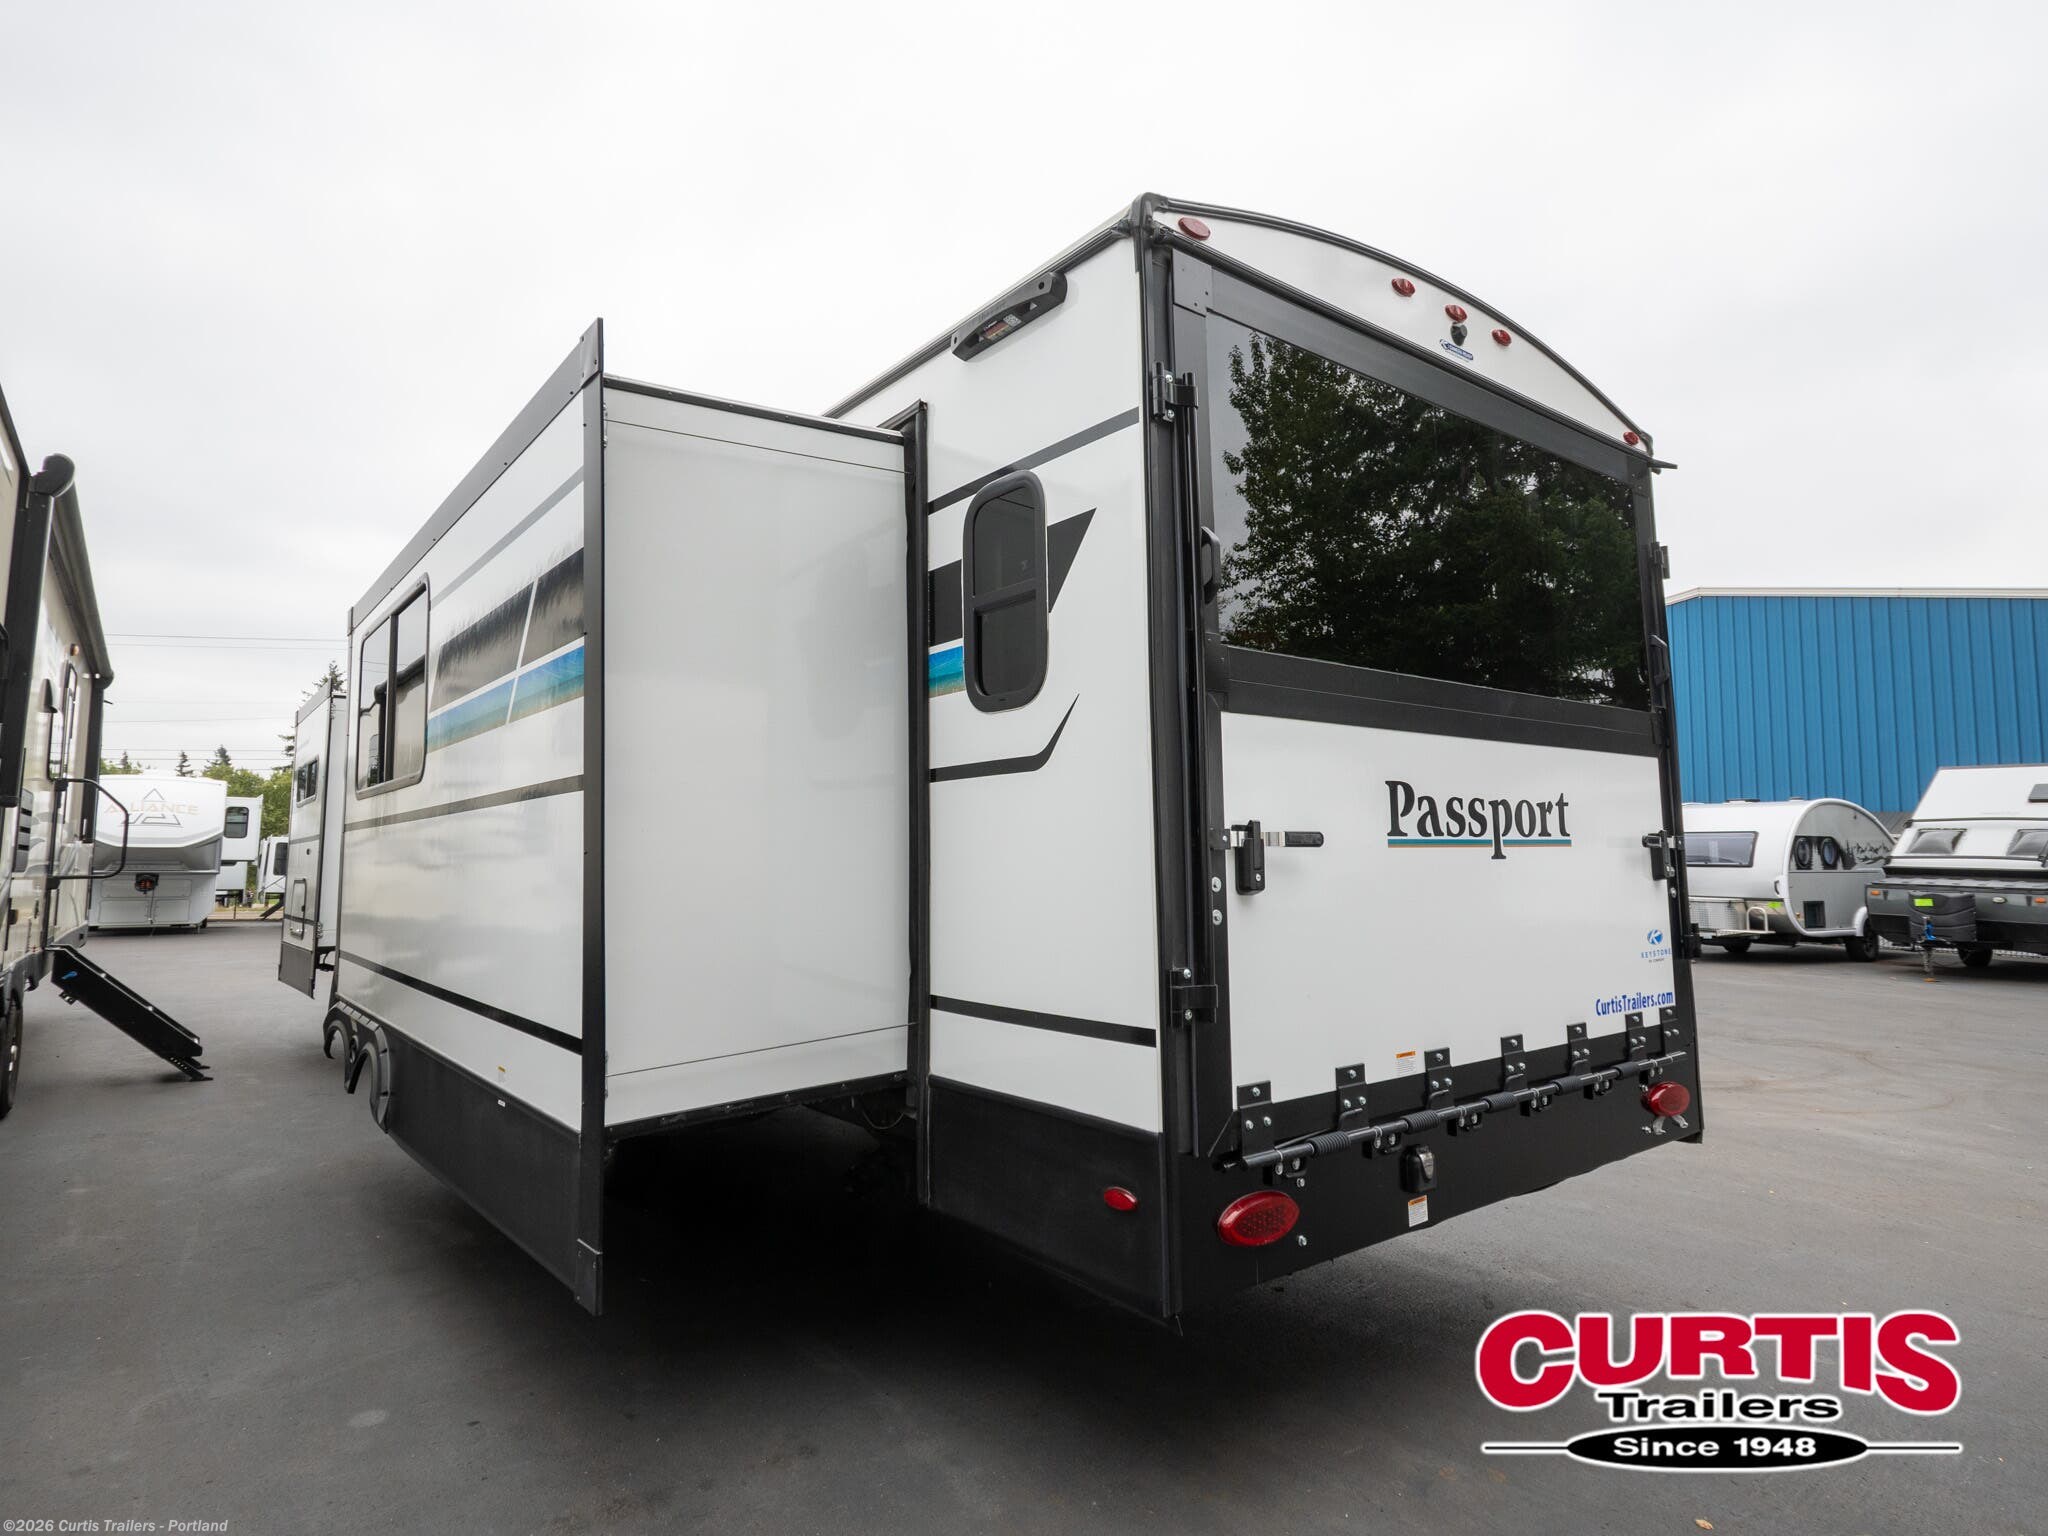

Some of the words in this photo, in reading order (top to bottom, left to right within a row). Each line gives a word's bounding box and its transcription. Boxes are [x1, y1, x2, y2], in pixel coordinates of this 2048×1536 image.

[104, 801, 200, 816] ALIANCE
[1384, 780, 1571, 860] Passport
[1595, 992, 1674, 1016] CurtisTrailers.com
